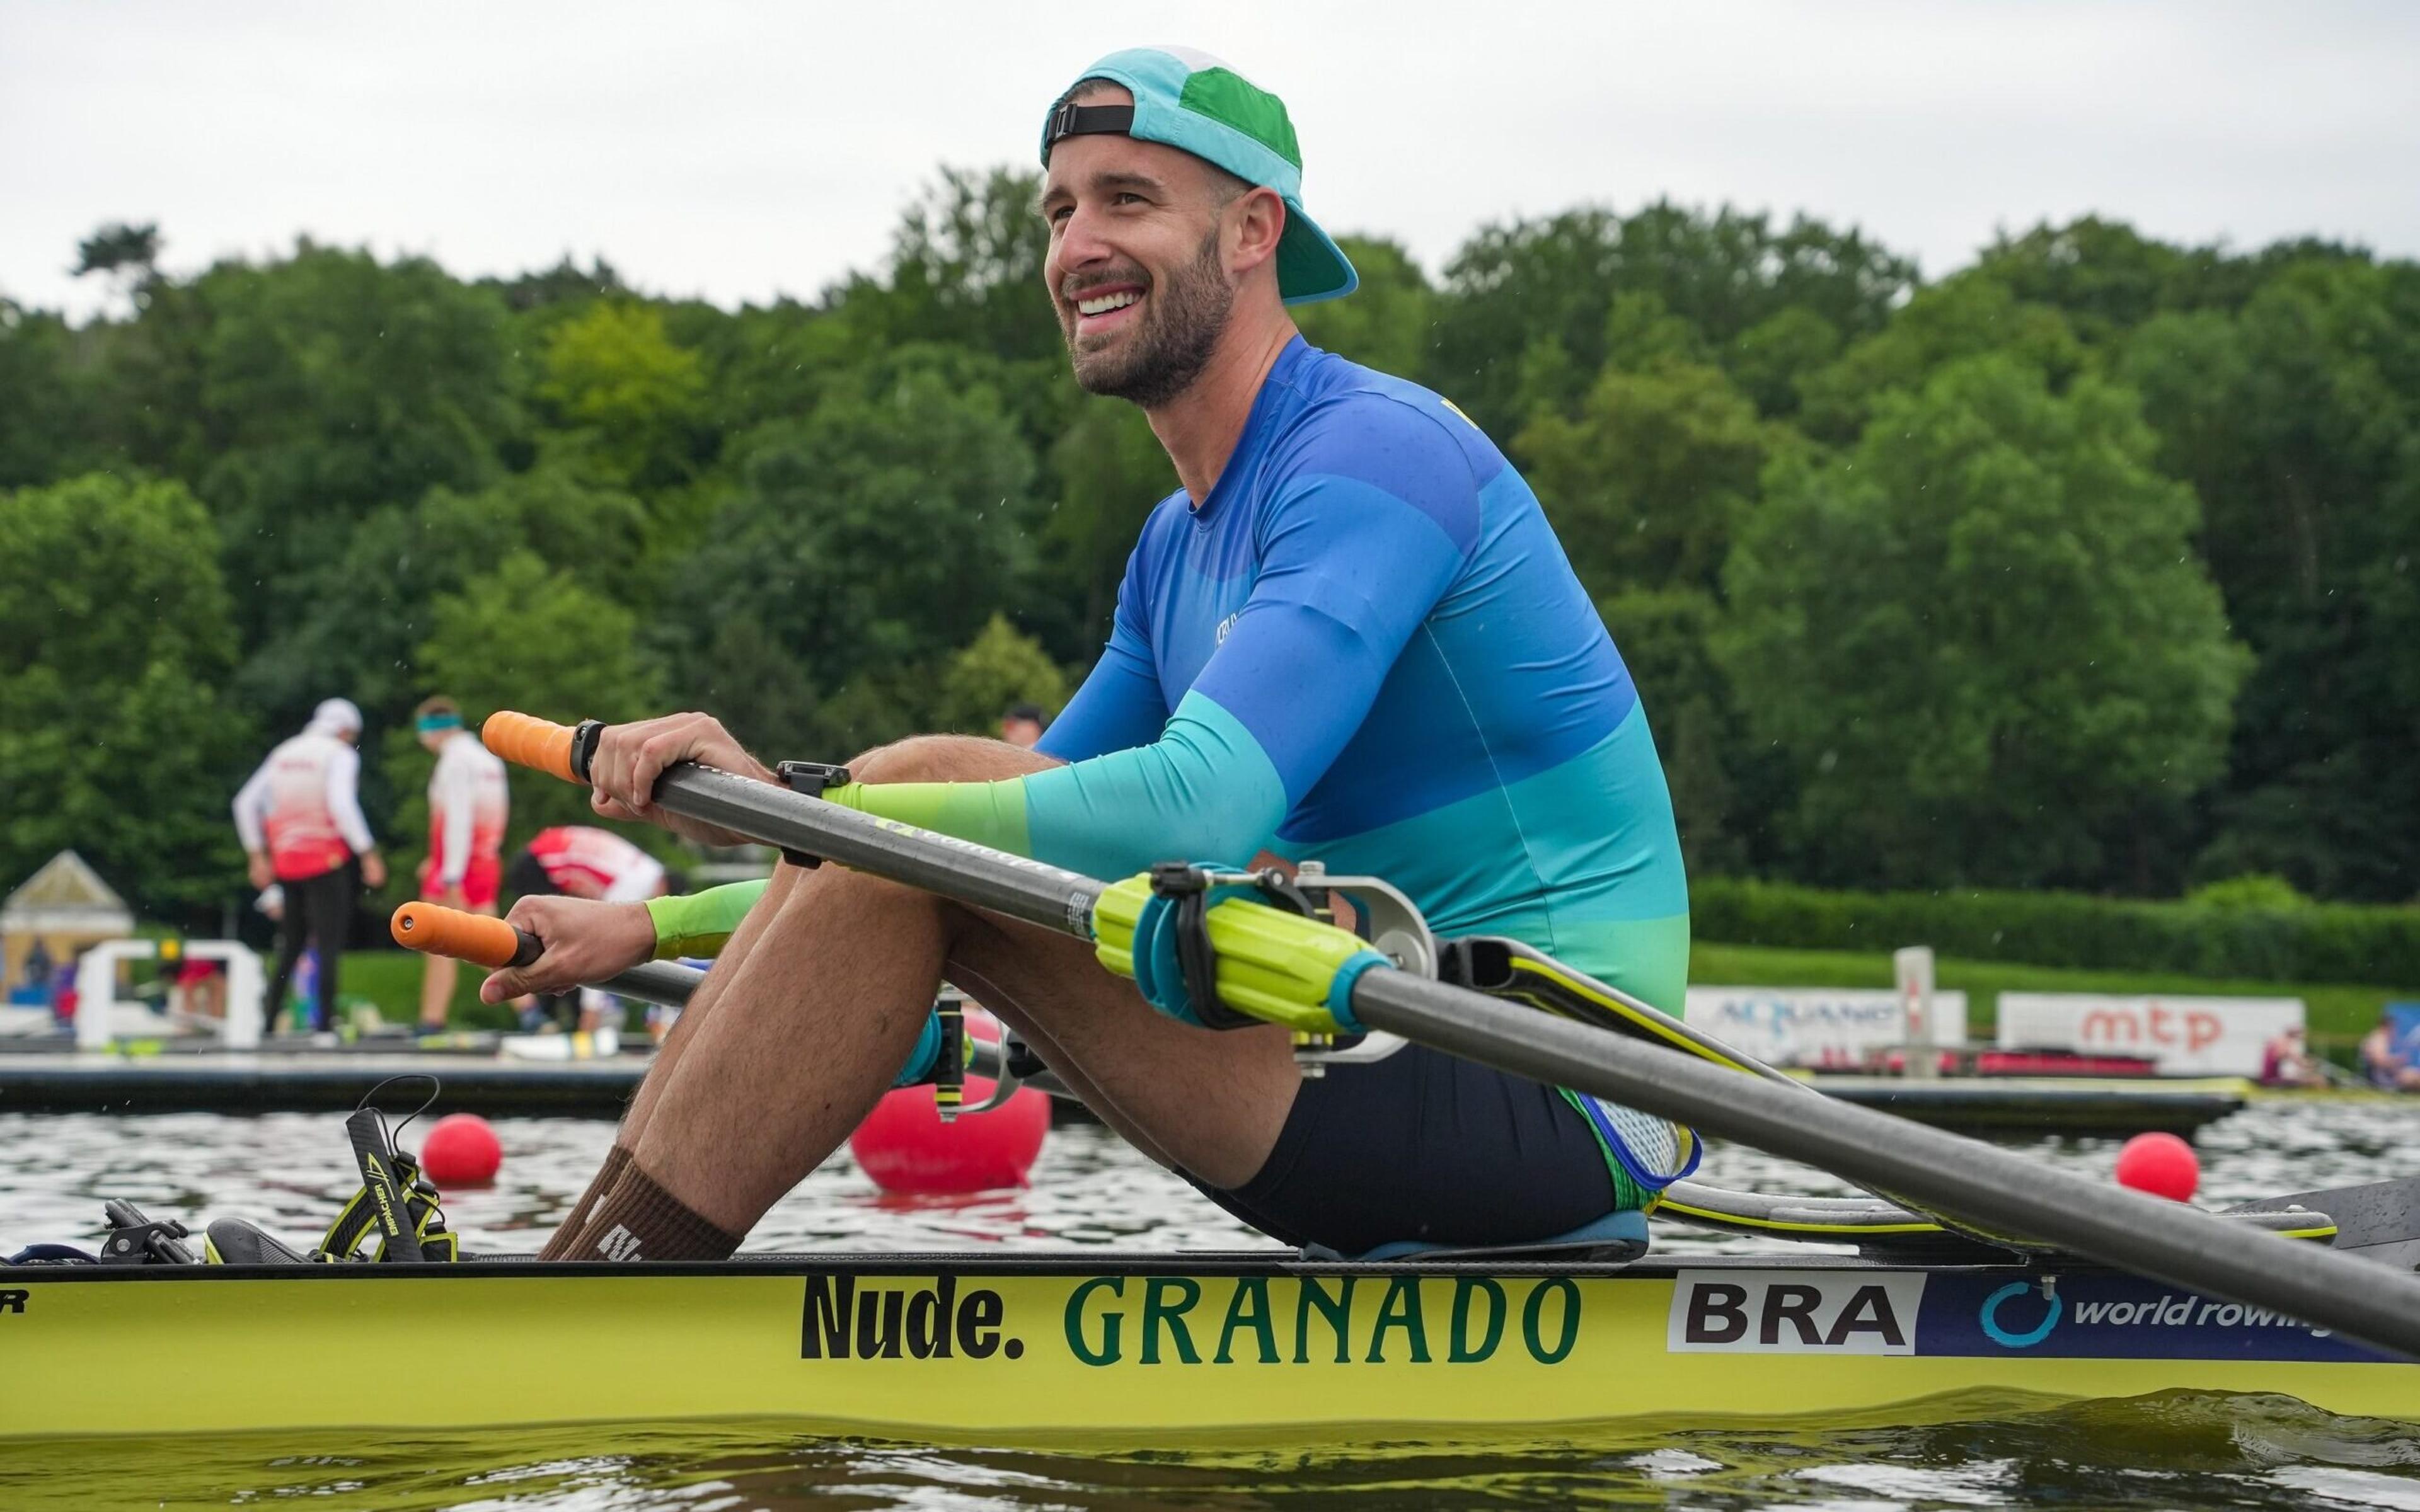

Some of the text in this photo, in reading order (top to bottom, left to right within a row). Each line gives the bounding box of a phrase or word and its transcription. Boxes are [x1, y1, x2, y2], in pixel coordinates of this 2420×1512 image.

[2082, 1004, 2225, 1053] mtp
[374, 1183, 400, 1237] EMPACHER
[801, 1275, 1025, 1360] Nude.
[1064, 1276, 1582, 1366] GRANADO
[1686, 1283, 1906, 1346] BRA
[2075, 1295, 2198, 1326] world
